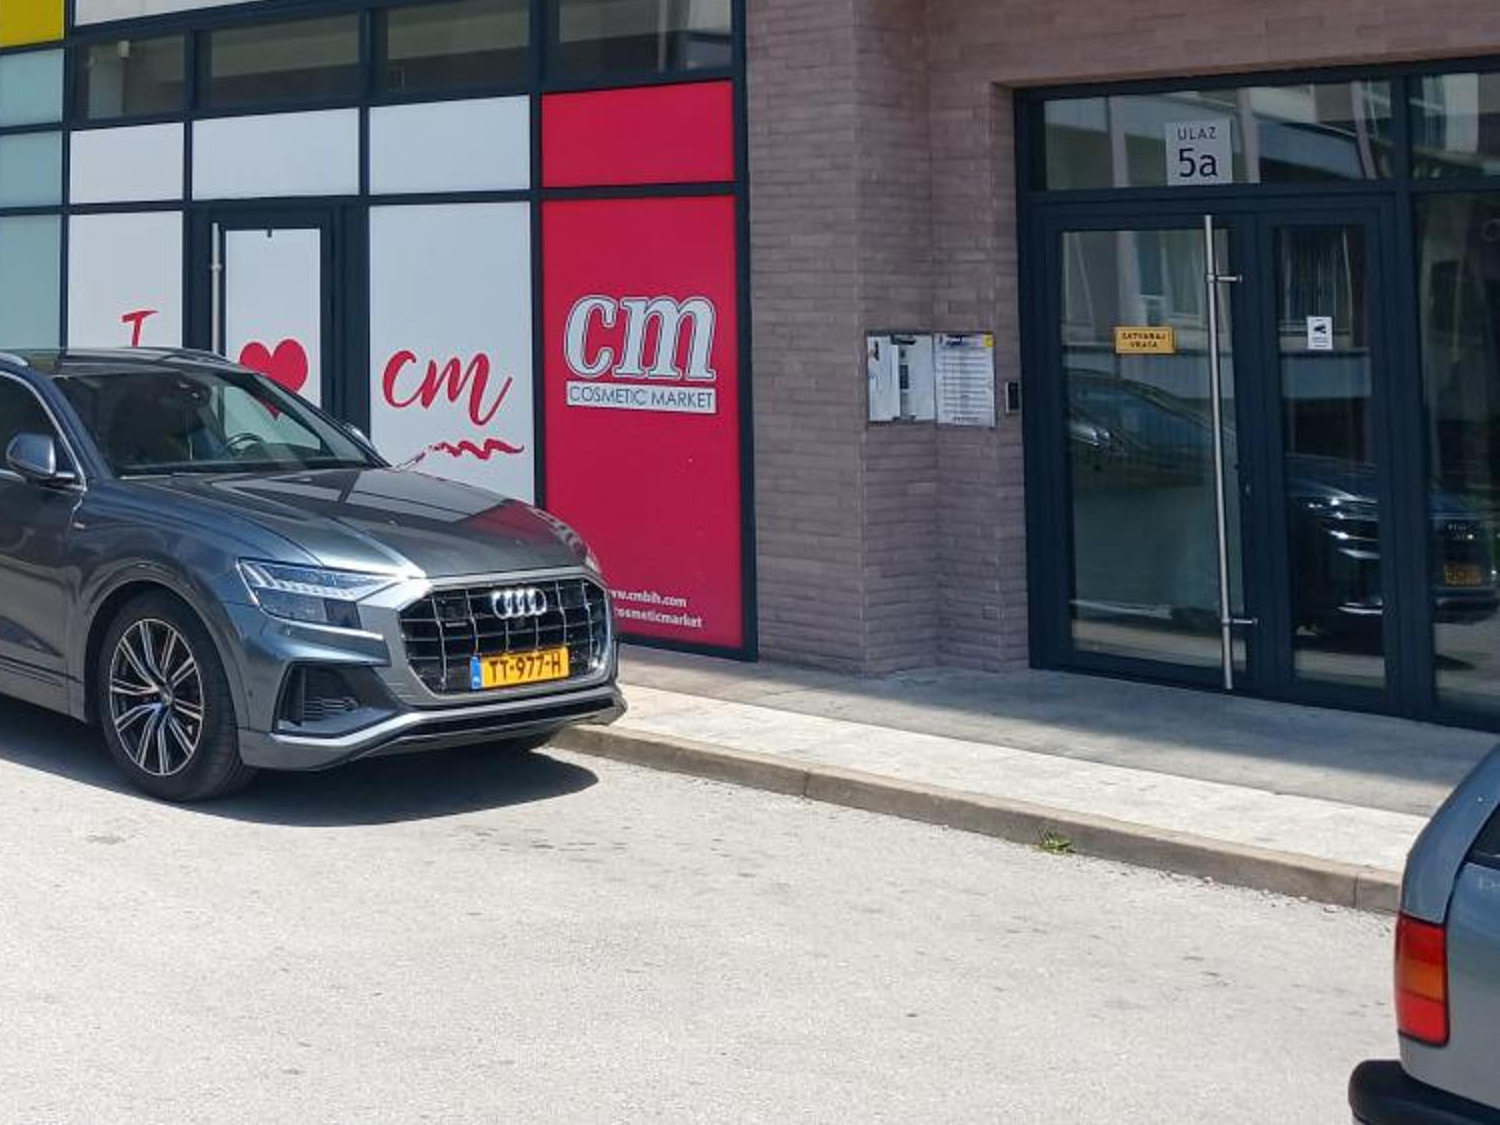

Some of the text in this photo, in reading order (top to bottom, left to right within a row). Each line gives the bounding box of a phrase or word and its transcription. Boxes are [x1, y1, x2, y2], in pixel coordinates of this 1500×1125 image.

[1177, 126, 1217, 140] ULAZ
[1179, 147, 1218, 178] 5a
[564, 294, 717, 382] cm
[382, 350, 513, 426] cm
[569, 386, 713, 409] COSMETIC MARKET
[489, 650, 561, 683] TT-977-H
